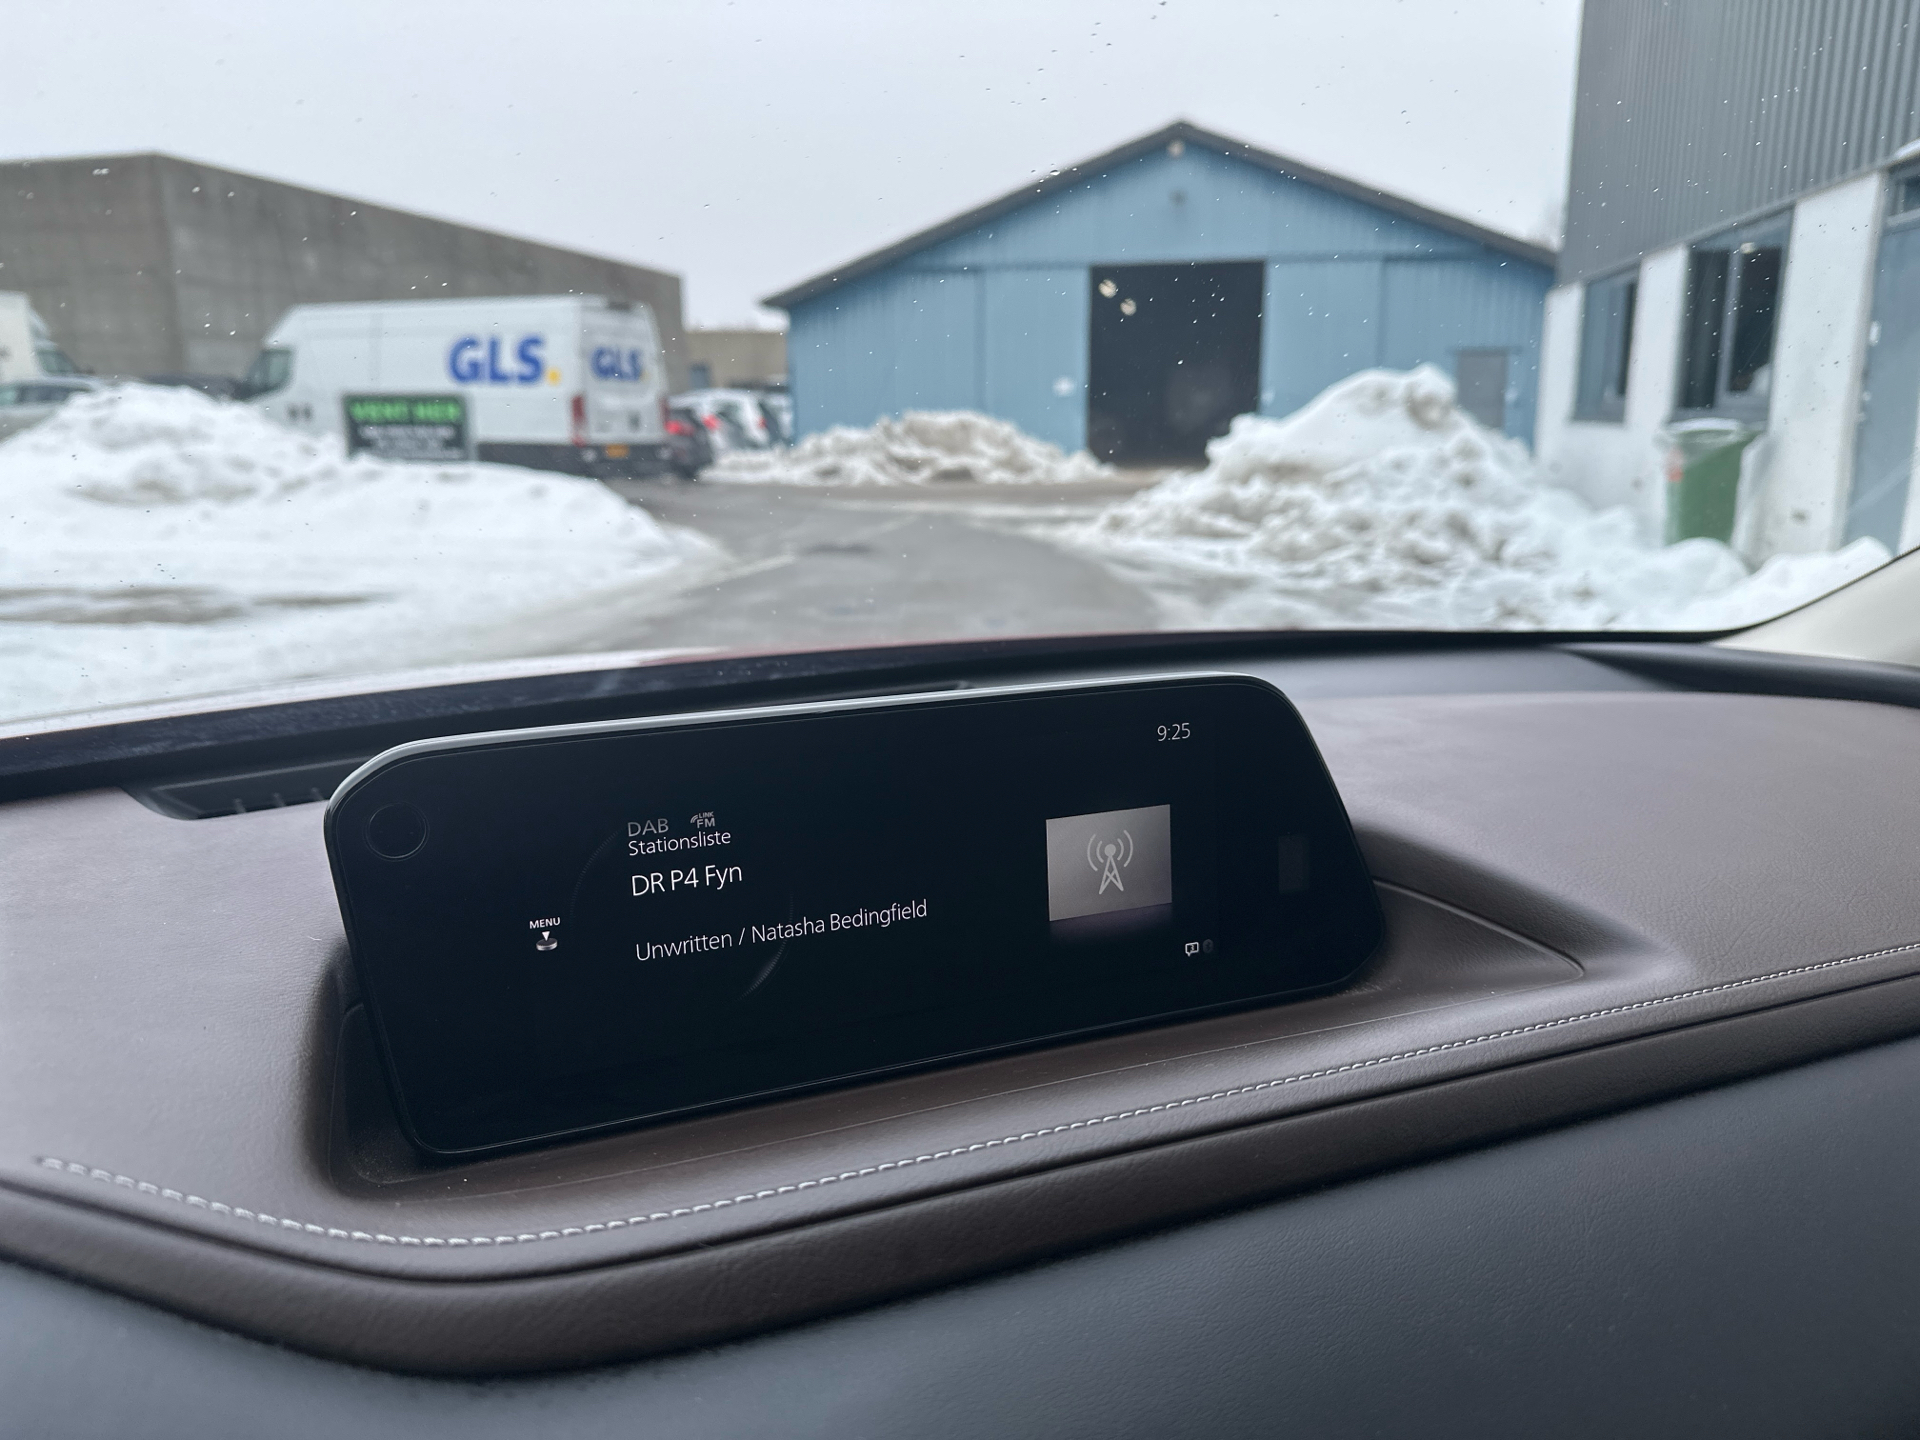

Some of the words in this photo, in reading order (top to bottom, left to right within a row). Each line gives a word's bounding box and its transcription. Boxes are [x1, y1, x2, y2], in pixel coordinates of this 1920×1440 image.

[1157, 722, 1191, 742] 9:25
[698, 811, 715, 819] LINK
[627, 818, 669, 837] DAB
[696, 816, 716, 829] FM
[628, 829, 732, 856] Stationsliste
[631, 871, 665, 896] DR
[670, 867, 699, 891] P4
[705, 862, 743, 890] Fyn
[529, 916, 561, 929] MENU
[635, 928, 733, 961] Unwritten
[738, 927, 746, 945] /
[751, 913, 826, 944] Natasha
[830, 899, 928, 931] Bedingfield
